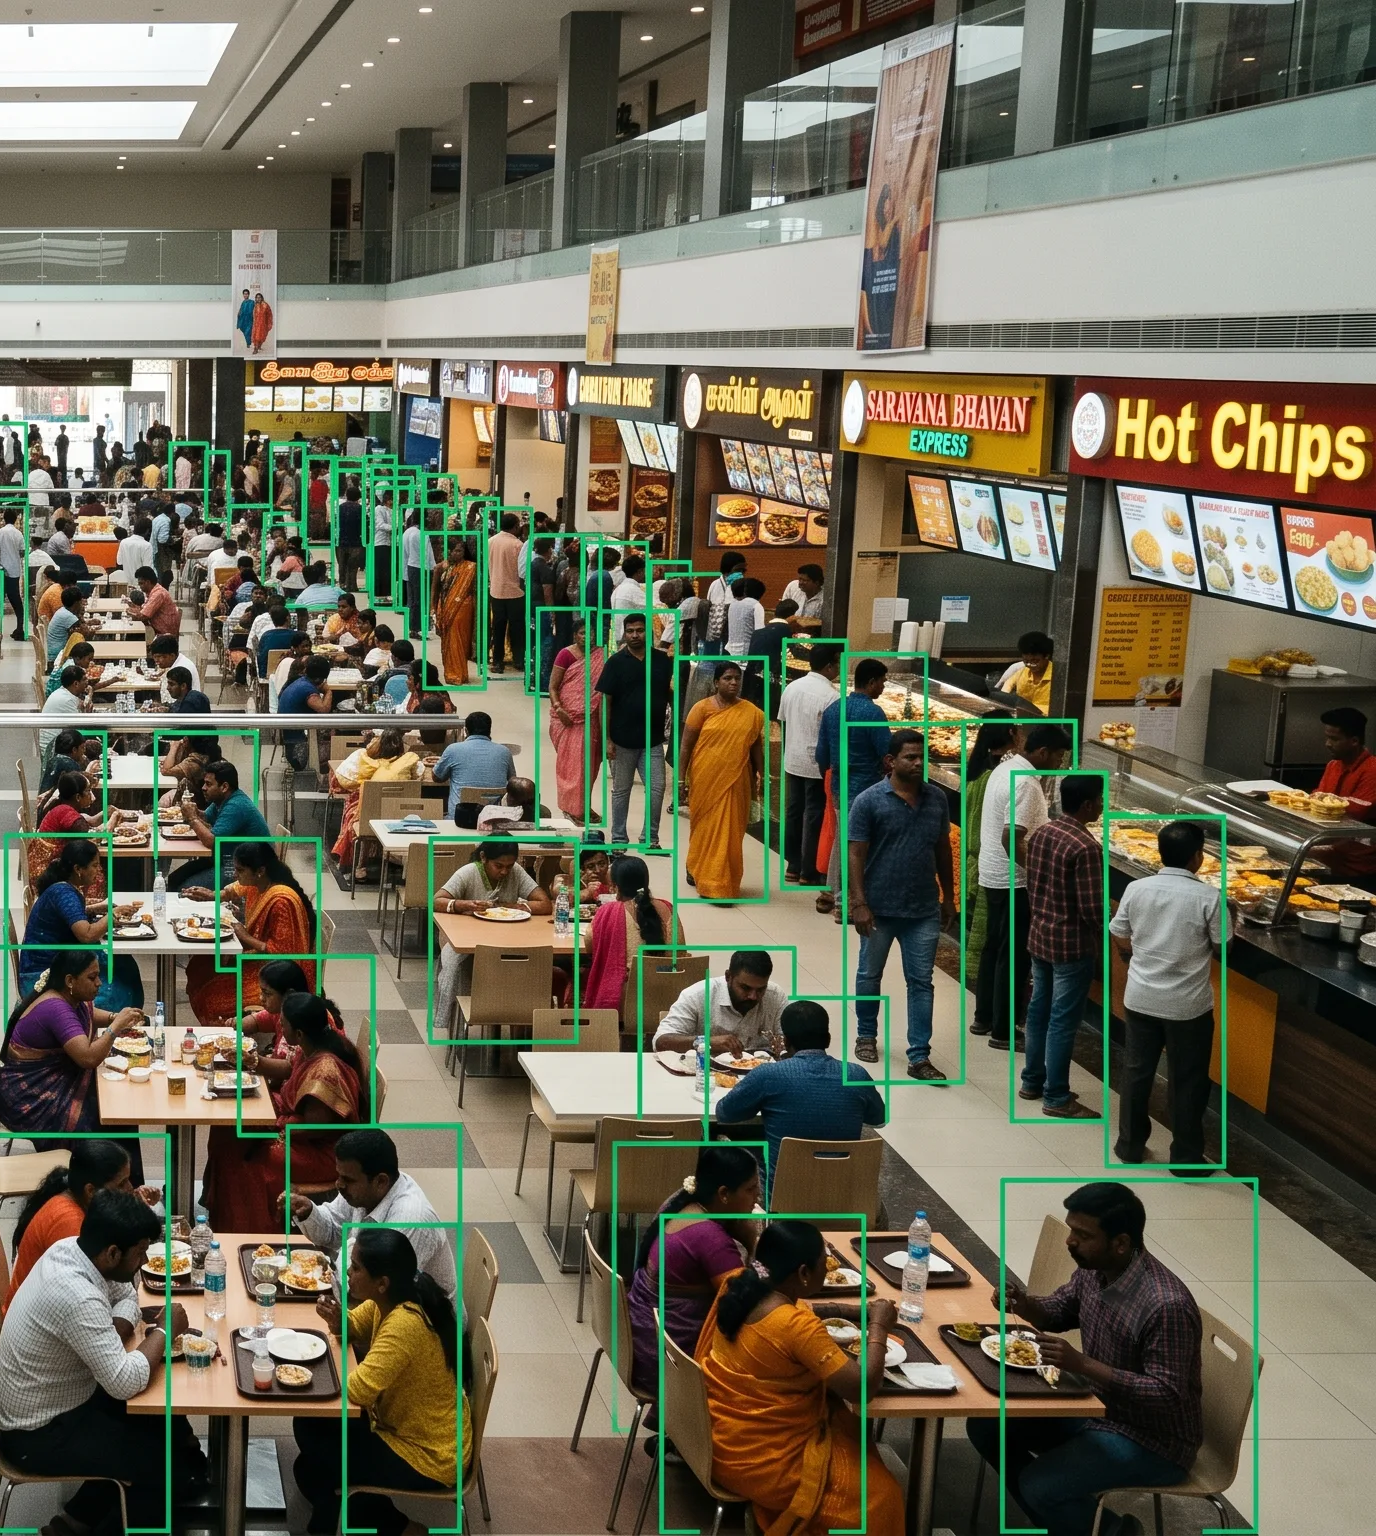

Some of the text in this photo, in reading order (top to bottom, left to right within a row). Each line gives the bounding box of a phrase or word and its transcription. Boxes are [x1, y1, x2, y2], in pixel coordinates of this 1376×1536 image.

[866, 390, 1031, 433] SARAVANA BHAVAN
[909, 429, 969, 458] EXPRESS
[1115, 397, 1368, 494] Hot Chips
